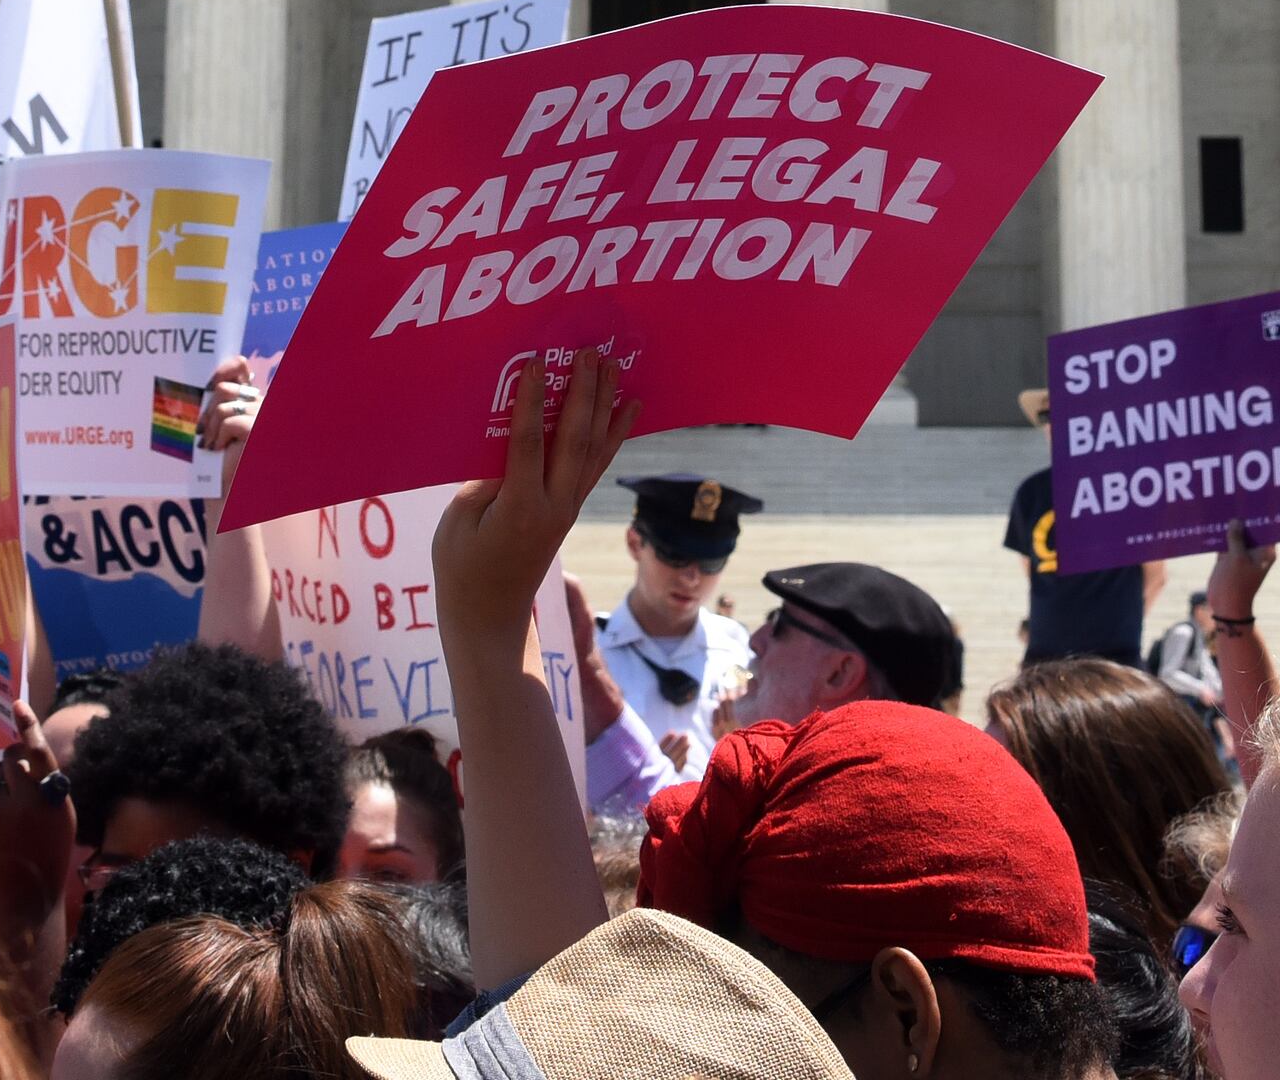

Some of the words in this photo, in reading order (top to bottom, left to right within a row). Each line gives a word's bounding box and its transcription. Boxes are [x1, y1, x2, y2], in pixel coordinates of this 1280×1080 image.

[371, 31, 424, 88] IF
[451, 2, 534, 67] IT'S
[503, 54, 932, 158] PROTECT
[383, 151, 628, 259] SAFE,
[646, 137, 942, 224] LEGAL
[250, 271, 324, 293] ABOR
[265, 247, 336, 269] ATIO
[370, 217, 872, 339] ABORTION
[20, 333, 53, 358] FOR
[58, 328, 217, 357] REPRODUCTIVE
[1064, 338, 1177, 394] STOP
[58, 371, 123, 396] EQUITY
[25, 426, 134, 449] www.URGE.org
[1068, 386, 1273, 456] BANNING
[41, 514, 83, 564] &
[318, 496, 396, 560] NO
